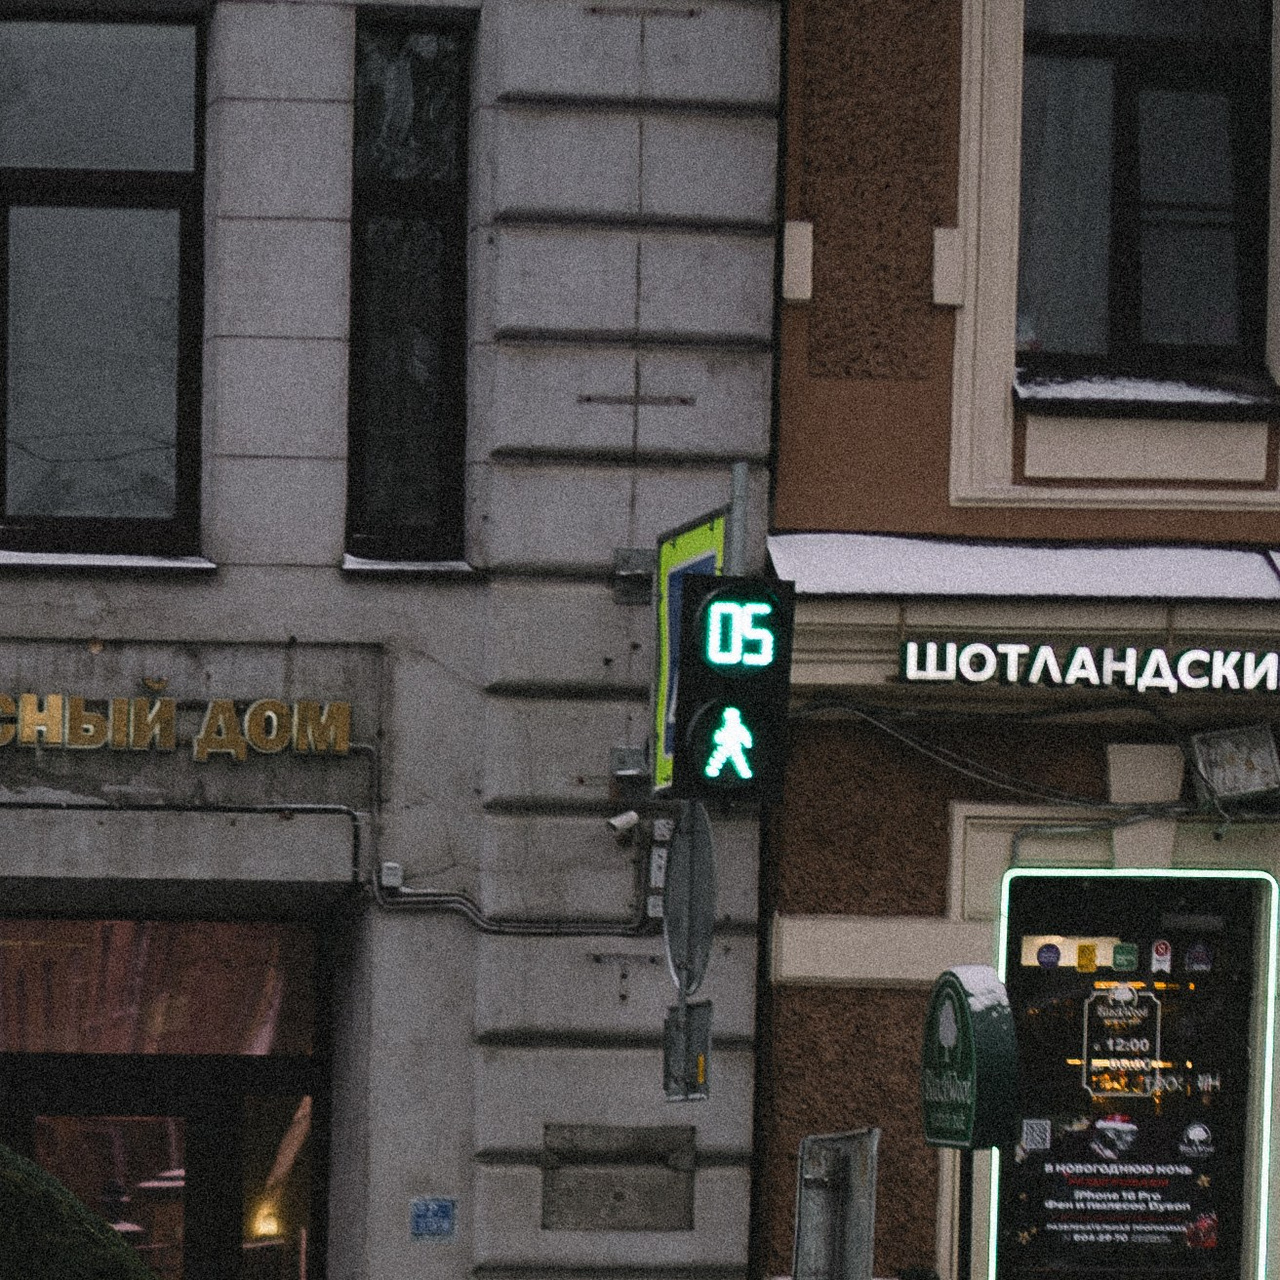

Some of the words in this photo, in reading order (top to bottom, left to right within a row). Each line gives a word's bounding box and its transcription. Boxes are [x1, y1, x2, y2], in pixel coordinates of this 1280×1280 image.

[707, 601, 774, 666] 05
[906, 641, 1279, 693] ШОТЛАНДСКИ
[193, 698, 352, 762] ДОМ
[1106, 1037, 1150, 1052] 12:00
